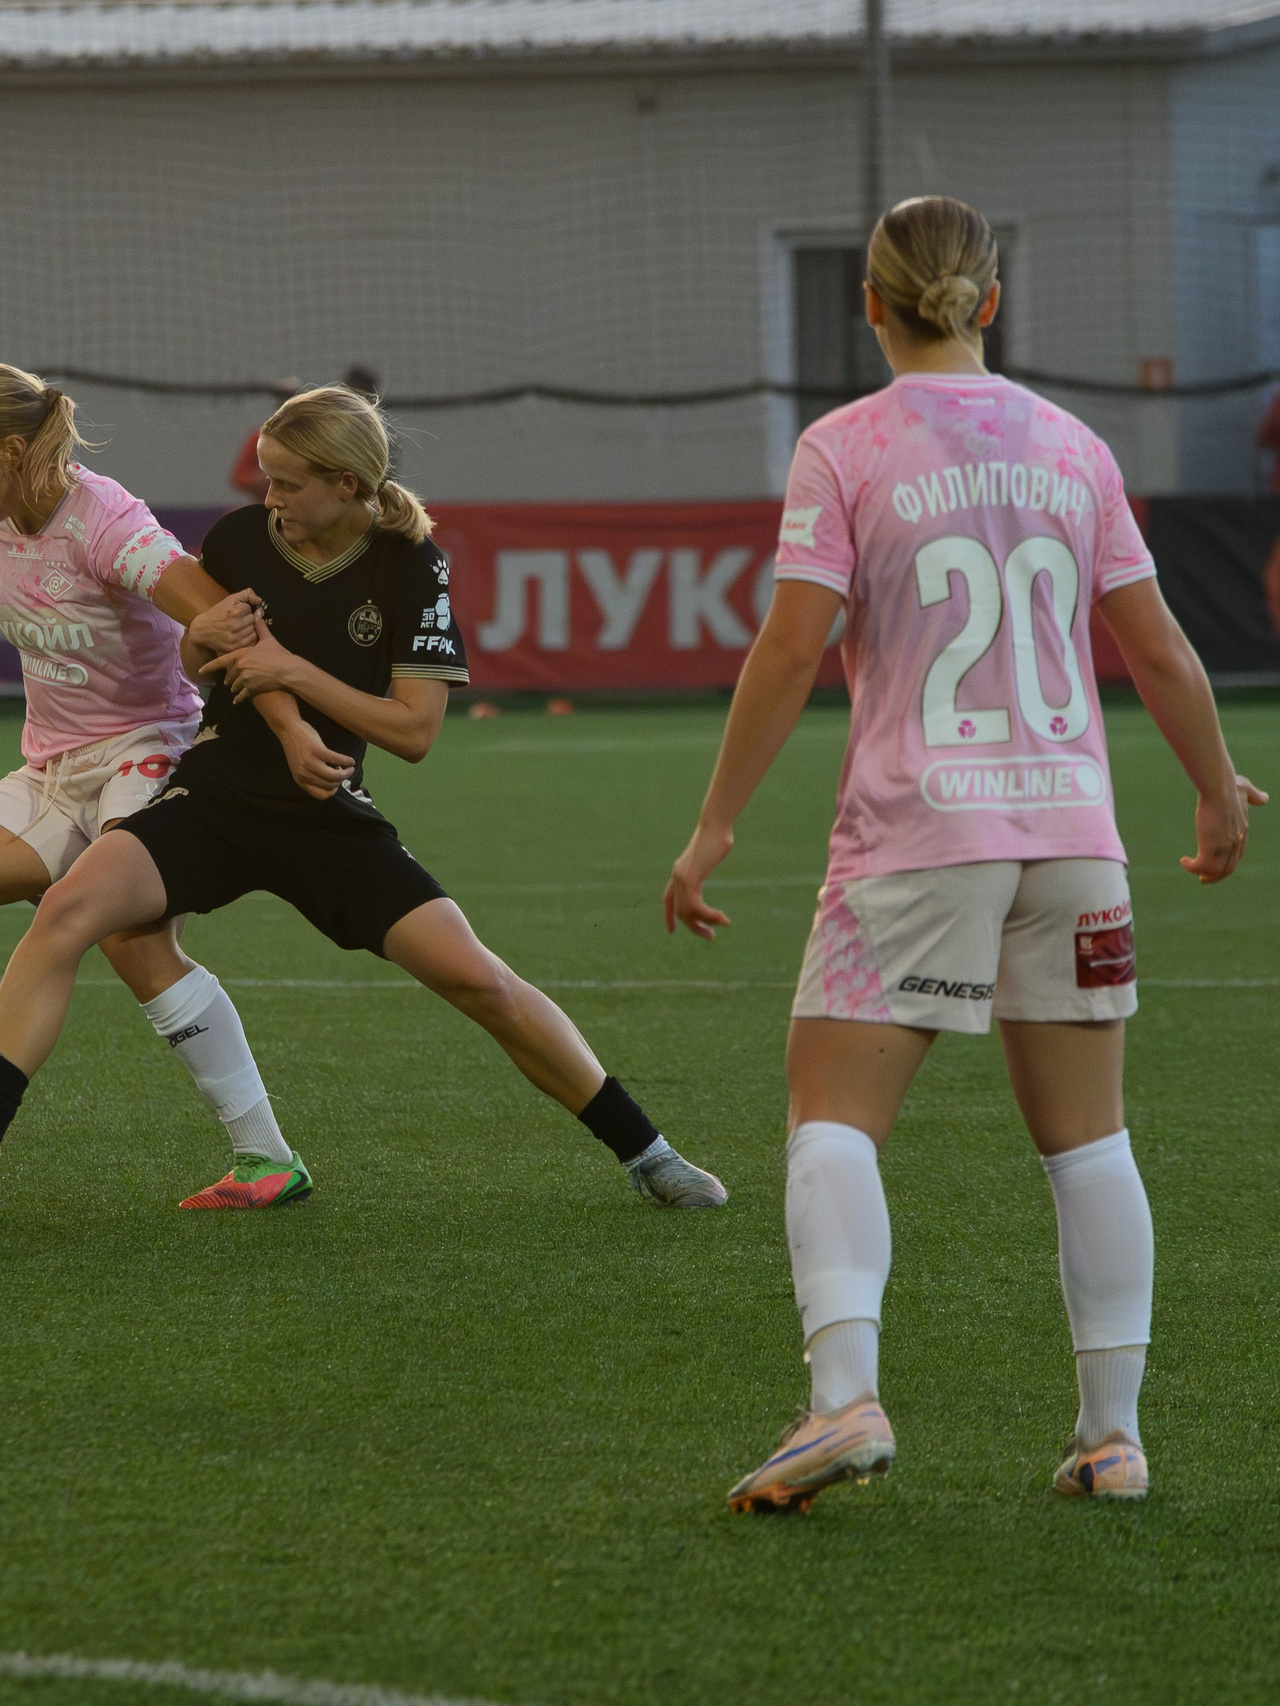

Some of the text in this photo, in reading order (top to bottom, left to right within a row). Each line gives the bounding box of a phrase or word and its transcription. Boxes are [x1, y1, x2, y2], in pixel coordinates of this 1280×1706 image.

[892, 462, 1089, 527] ФИЛИПОВИЧ
[422, 612, 435, 621] 30
[915, 536, 1089, 747] 20
[21, 651, 67, 680] WINLINE
[939, 767, 1072, 799] WINLINE
